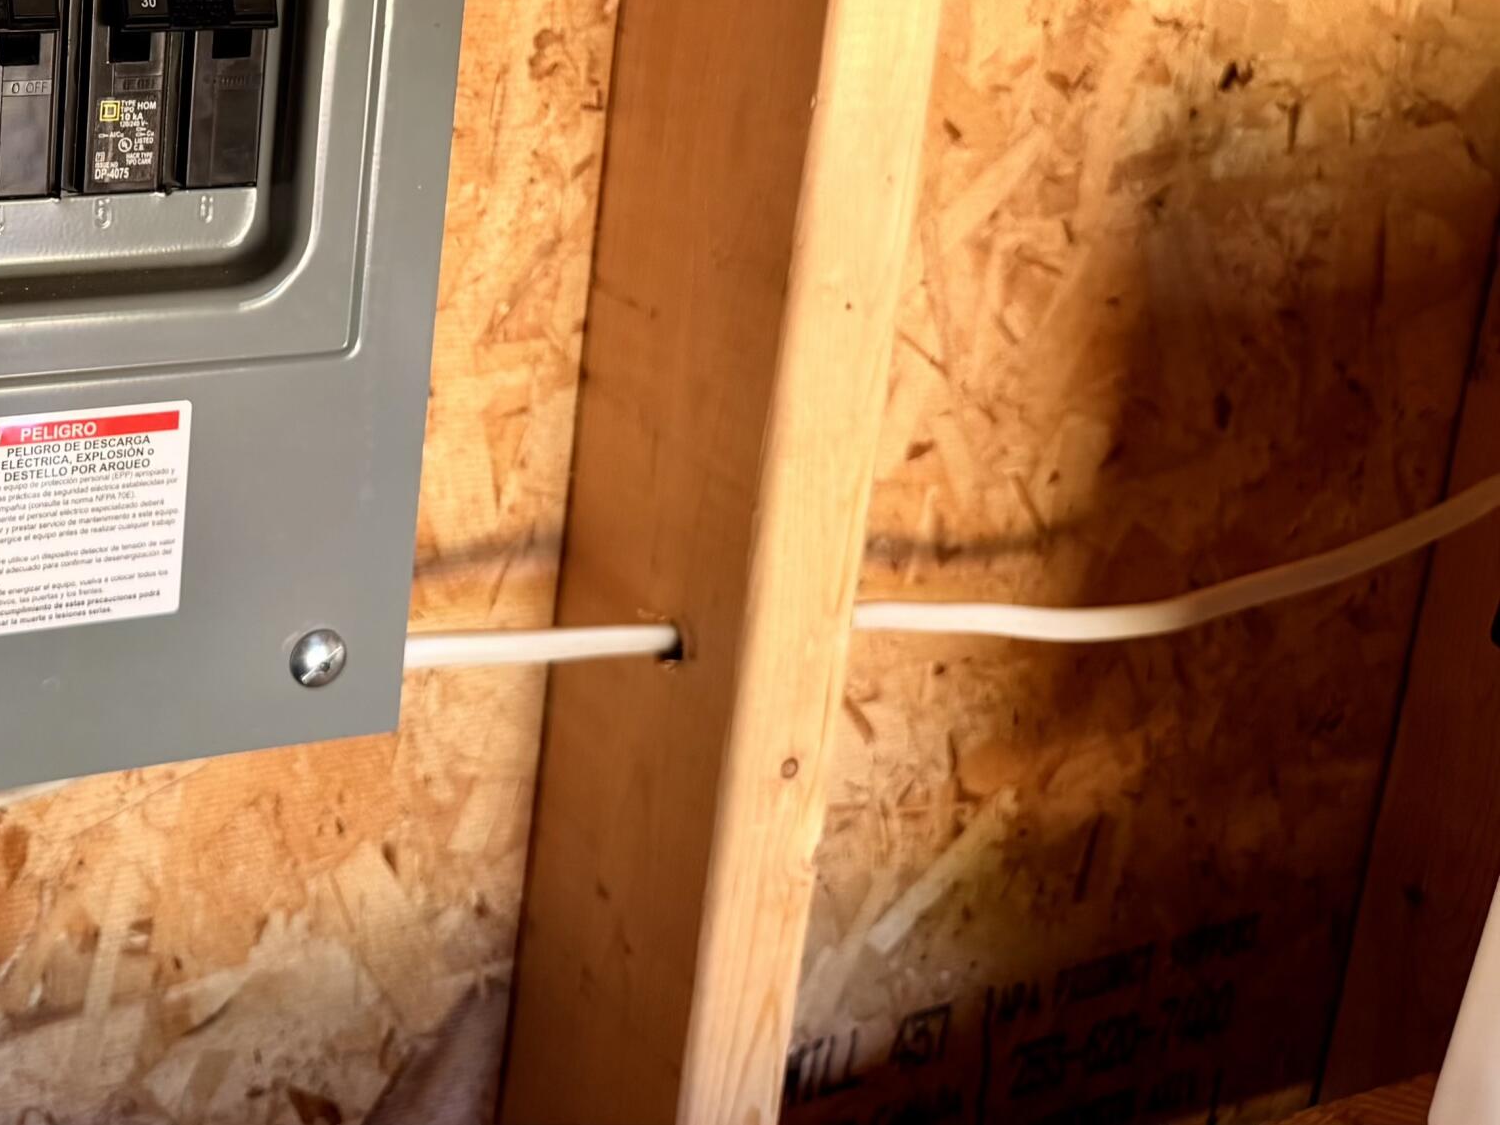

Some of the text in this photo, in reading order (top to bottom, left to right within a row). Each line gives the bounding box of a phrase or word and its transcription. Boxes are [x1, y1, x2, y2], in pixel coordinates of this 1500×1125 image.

[137, 101, 156, 110] HOM
[95, 167, 129, 179] DP-4075
[20, 421, 97, 442] PELIGRO
[6, 434, 150, 457] PELIGRO DE DESCARGA
[76, 445, 145, 463] EXPLOSIÓN
[3, 458, 150, 482] DESTELLO POR ARQUEO
